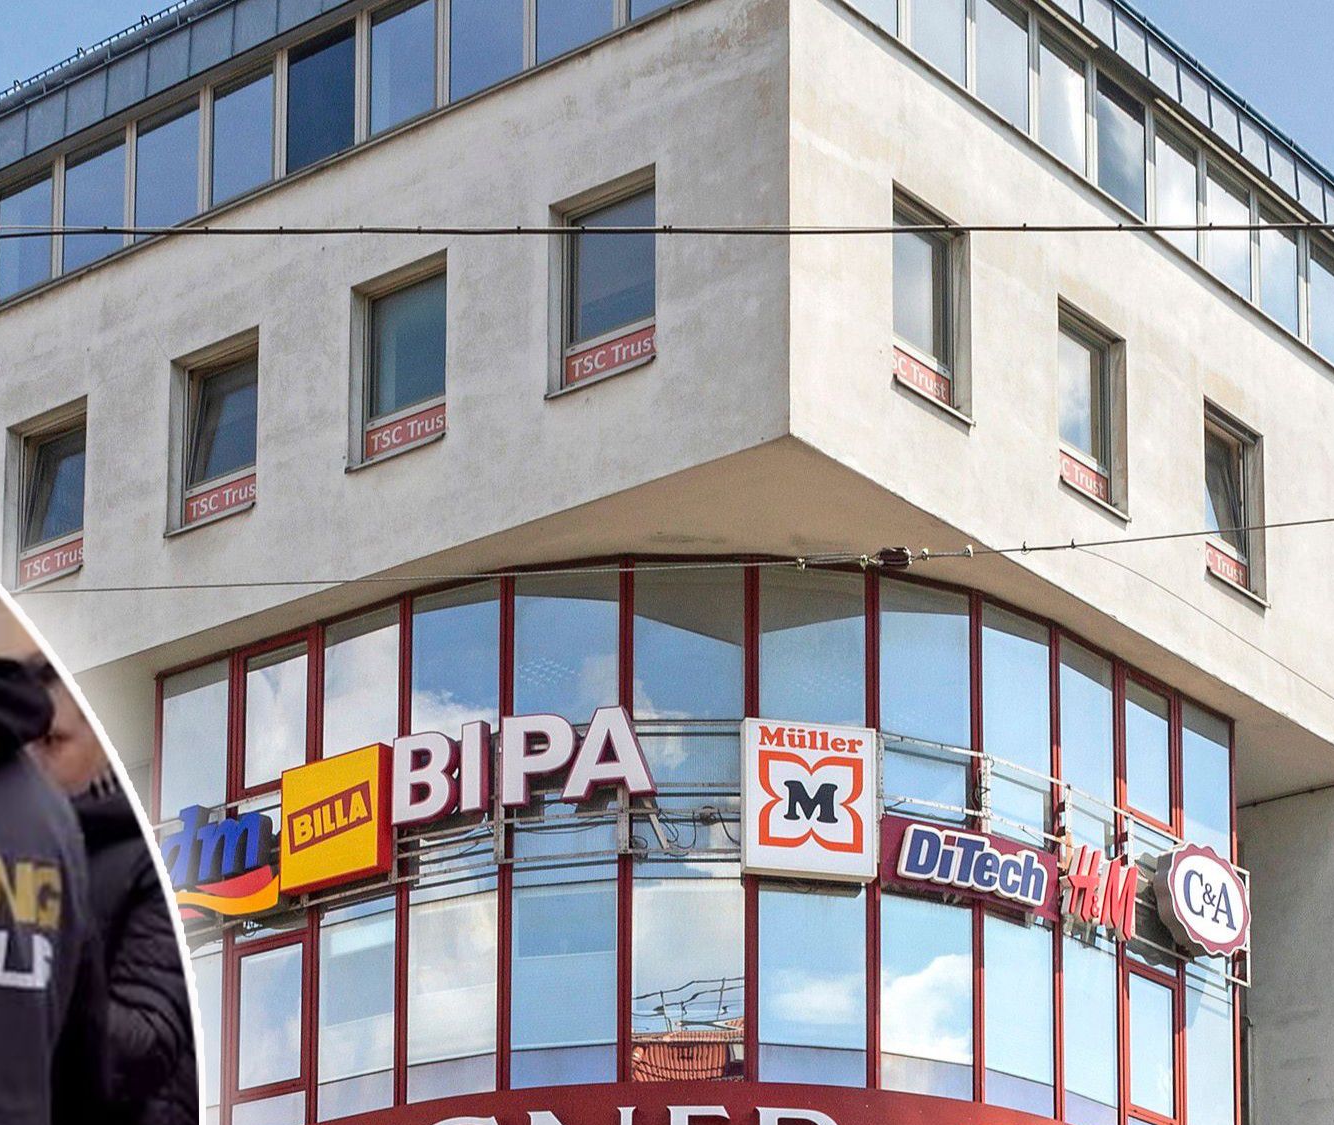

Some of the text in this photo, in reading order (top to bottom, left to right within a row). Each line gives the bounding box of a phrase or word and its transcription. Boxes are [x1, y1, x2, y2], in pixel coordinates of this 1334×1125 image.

[571, 350, 606, 377] TSC
[910, 362, 947, 401] Trust
[370, 414, 446, 452] TSC Trus
[1072, 465, 1104, 499] Trust
[190, 494, 219, 518] TSC
[24, 556, 50, 578] TSC
[1215, 553, 1245, 585] Trust
[758, 725, 863, 754] Müller
[393, 706, 658, 828] BIPA
[293, 791, 368, 841] BILLA
[783, 780, 839, 824] M
[162, 804, 267, 888] dm
[898, 824, 1047, 907] DiTech
[1062, 844, 1138, 942] H&M
[1182, 867, 1238, 932] C&A
